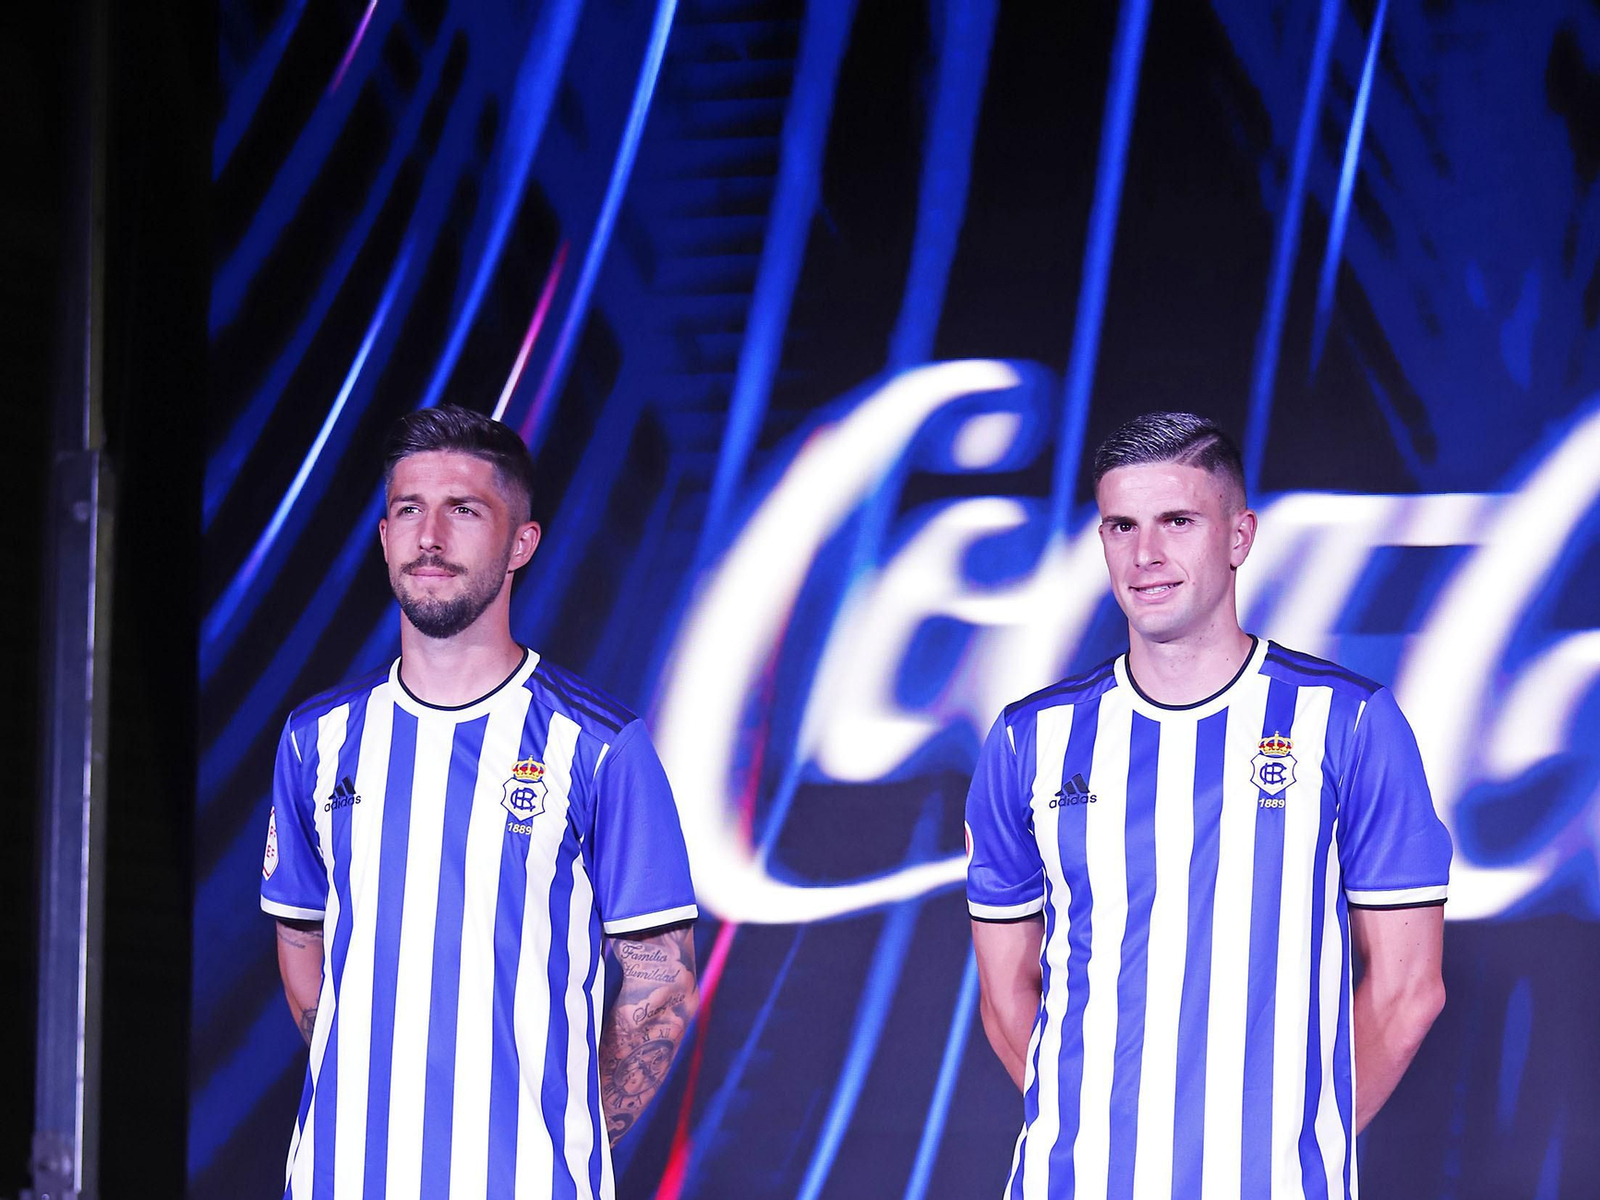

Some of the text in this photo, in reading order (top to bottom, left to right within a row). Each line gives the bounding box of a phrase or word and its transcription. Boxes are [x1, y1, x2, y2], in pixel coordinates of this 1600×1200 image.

[324, 795, 361, 812] adidas
[1049, 794, 1097, 809] adidas
[1259, 798, 1285, 809] 1889
[508, 822, 532, 835] 1889
[621, 943, 667, 961] Familia
[623, 962, 680, 983] Humildad
